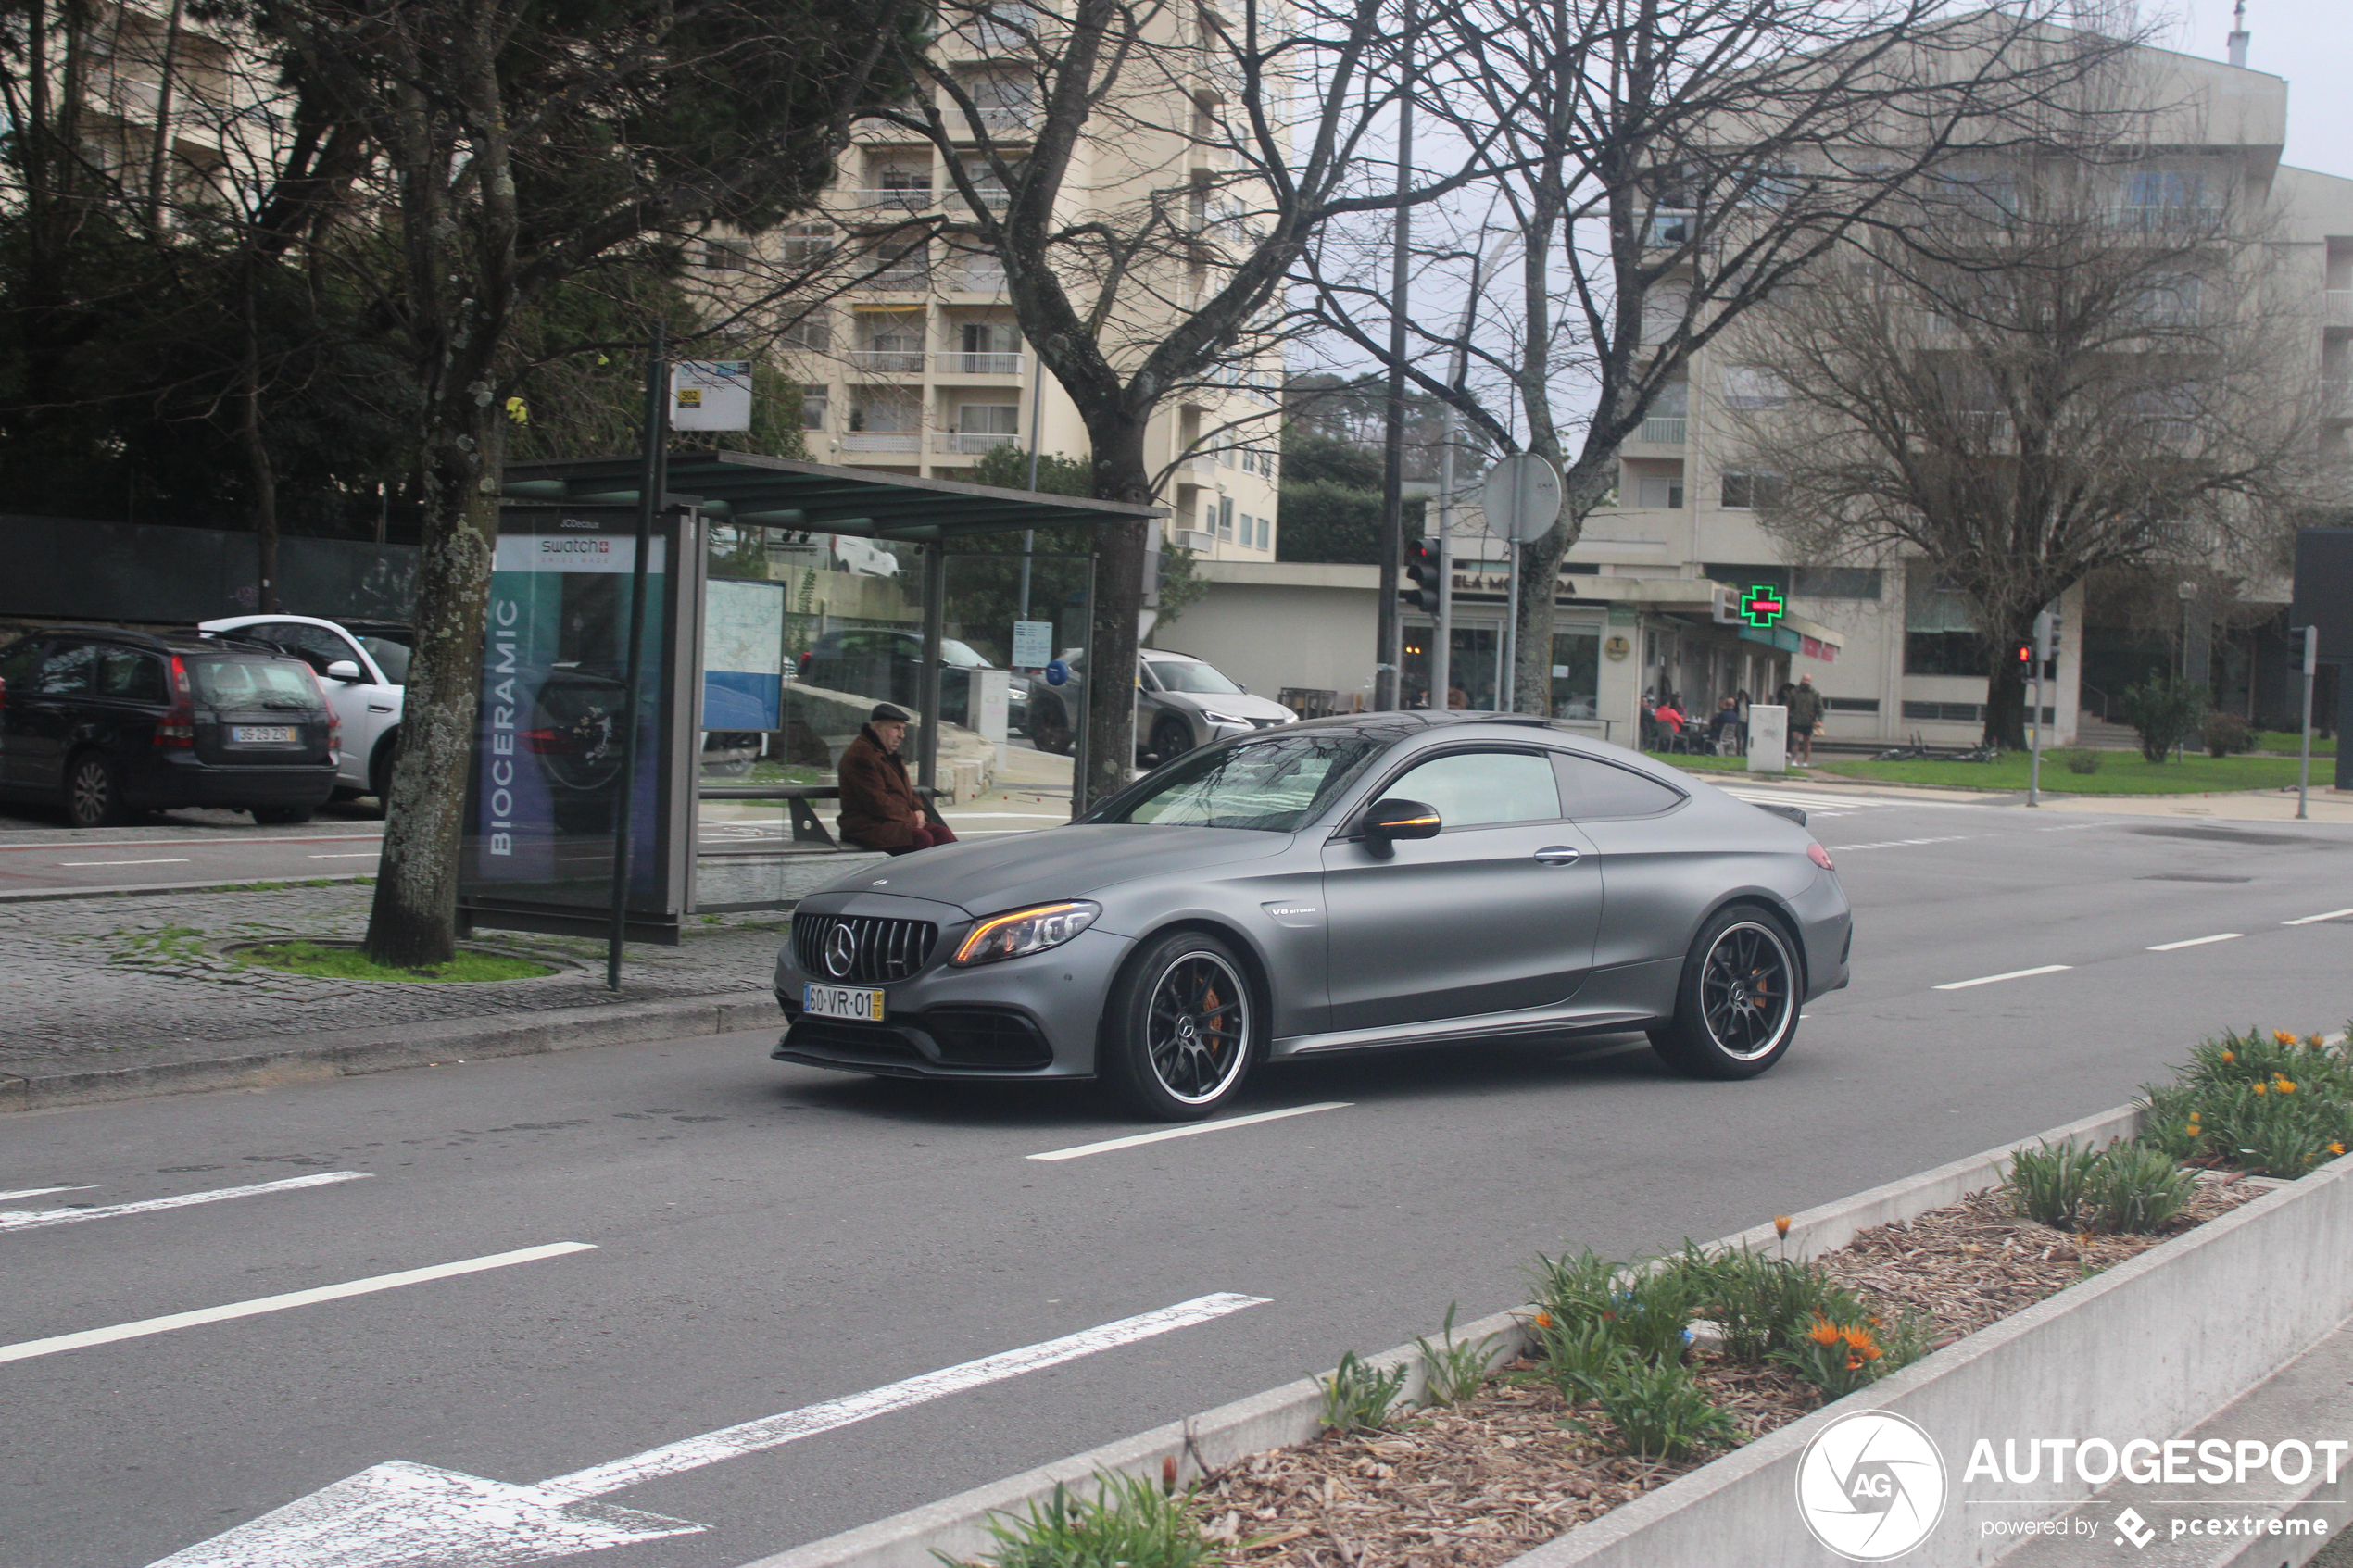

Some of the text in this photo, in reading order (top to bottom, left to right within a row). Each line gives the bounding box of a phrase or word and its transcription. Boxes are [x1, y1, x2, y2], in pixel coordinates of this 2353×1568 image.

[681, 390, 698, 401] 502
[542, 539, 598, 553] swatch
[490, 599, 518, 856] BIOCERAMIC
